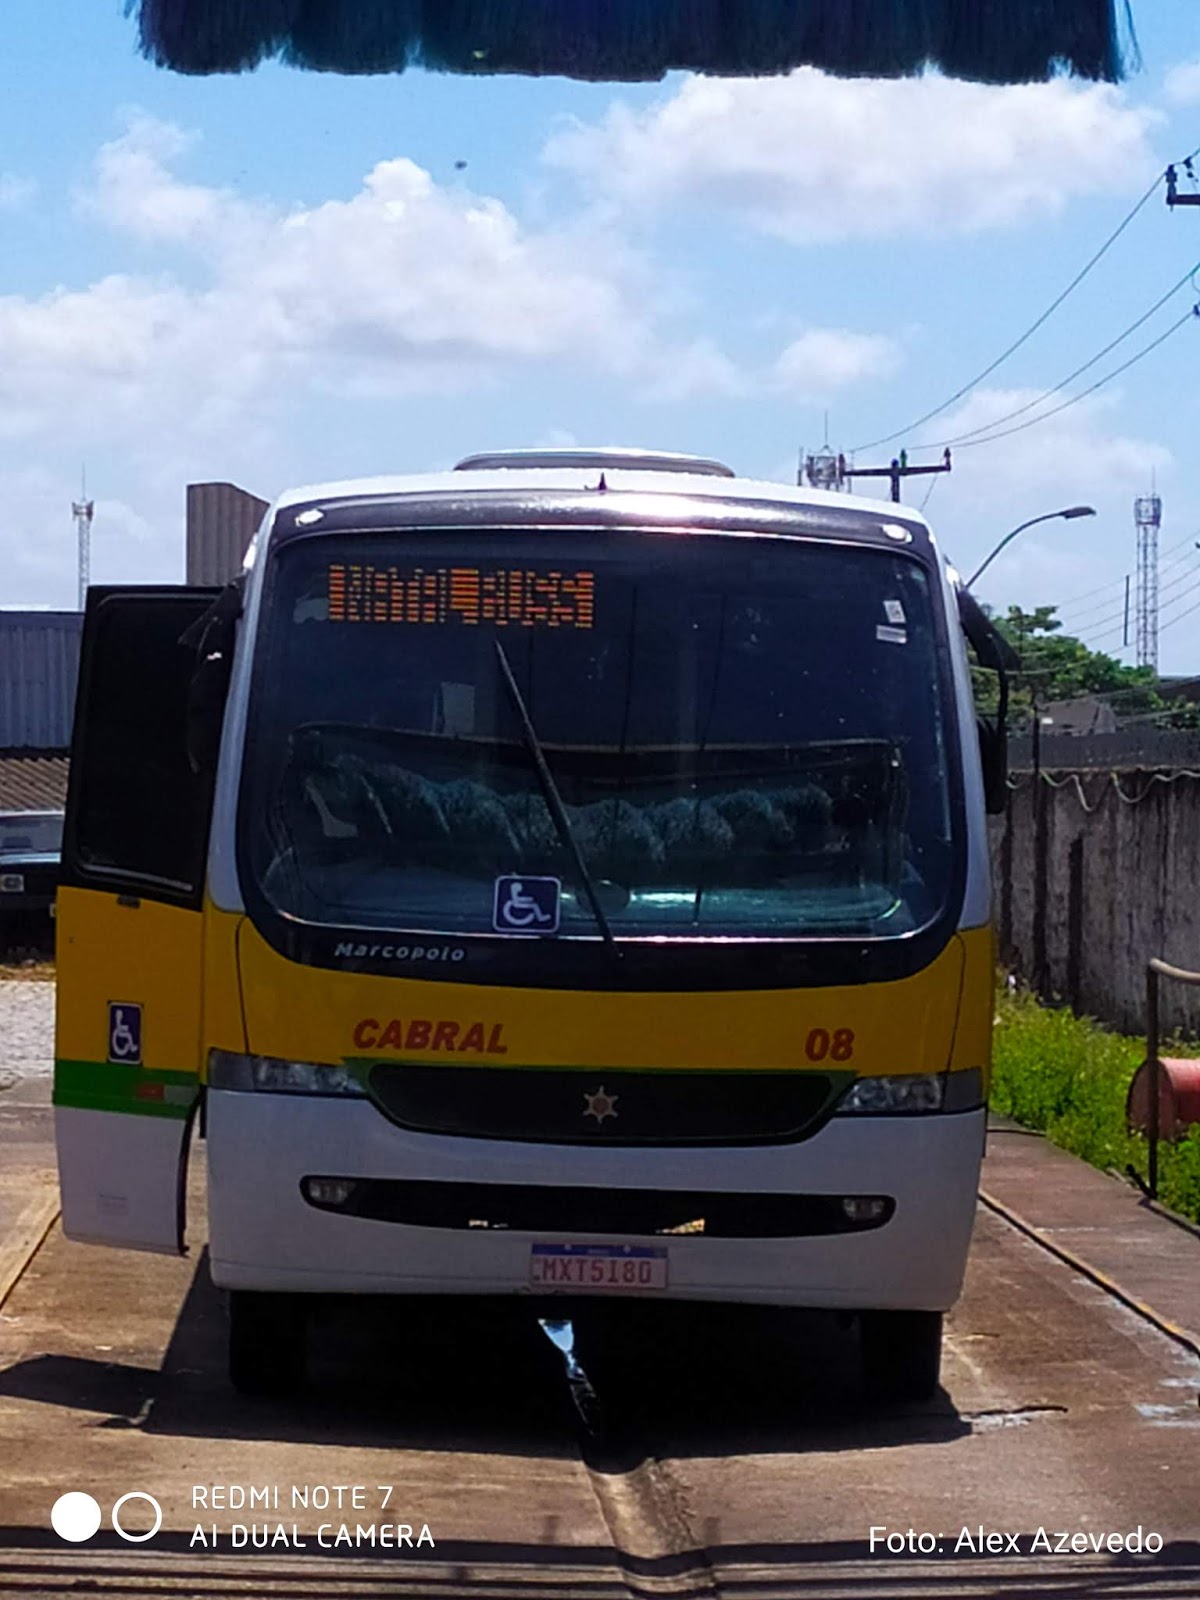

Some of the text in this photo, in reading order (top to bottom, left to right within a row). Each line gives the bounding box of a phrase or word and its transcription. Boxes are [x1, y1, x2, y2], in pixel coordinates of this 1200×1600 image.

[334, 942, 465, 963] Marcopolo
[353, 1018, 508, 1054] CABRAL
[804, 1027, 855, 1062] 08
